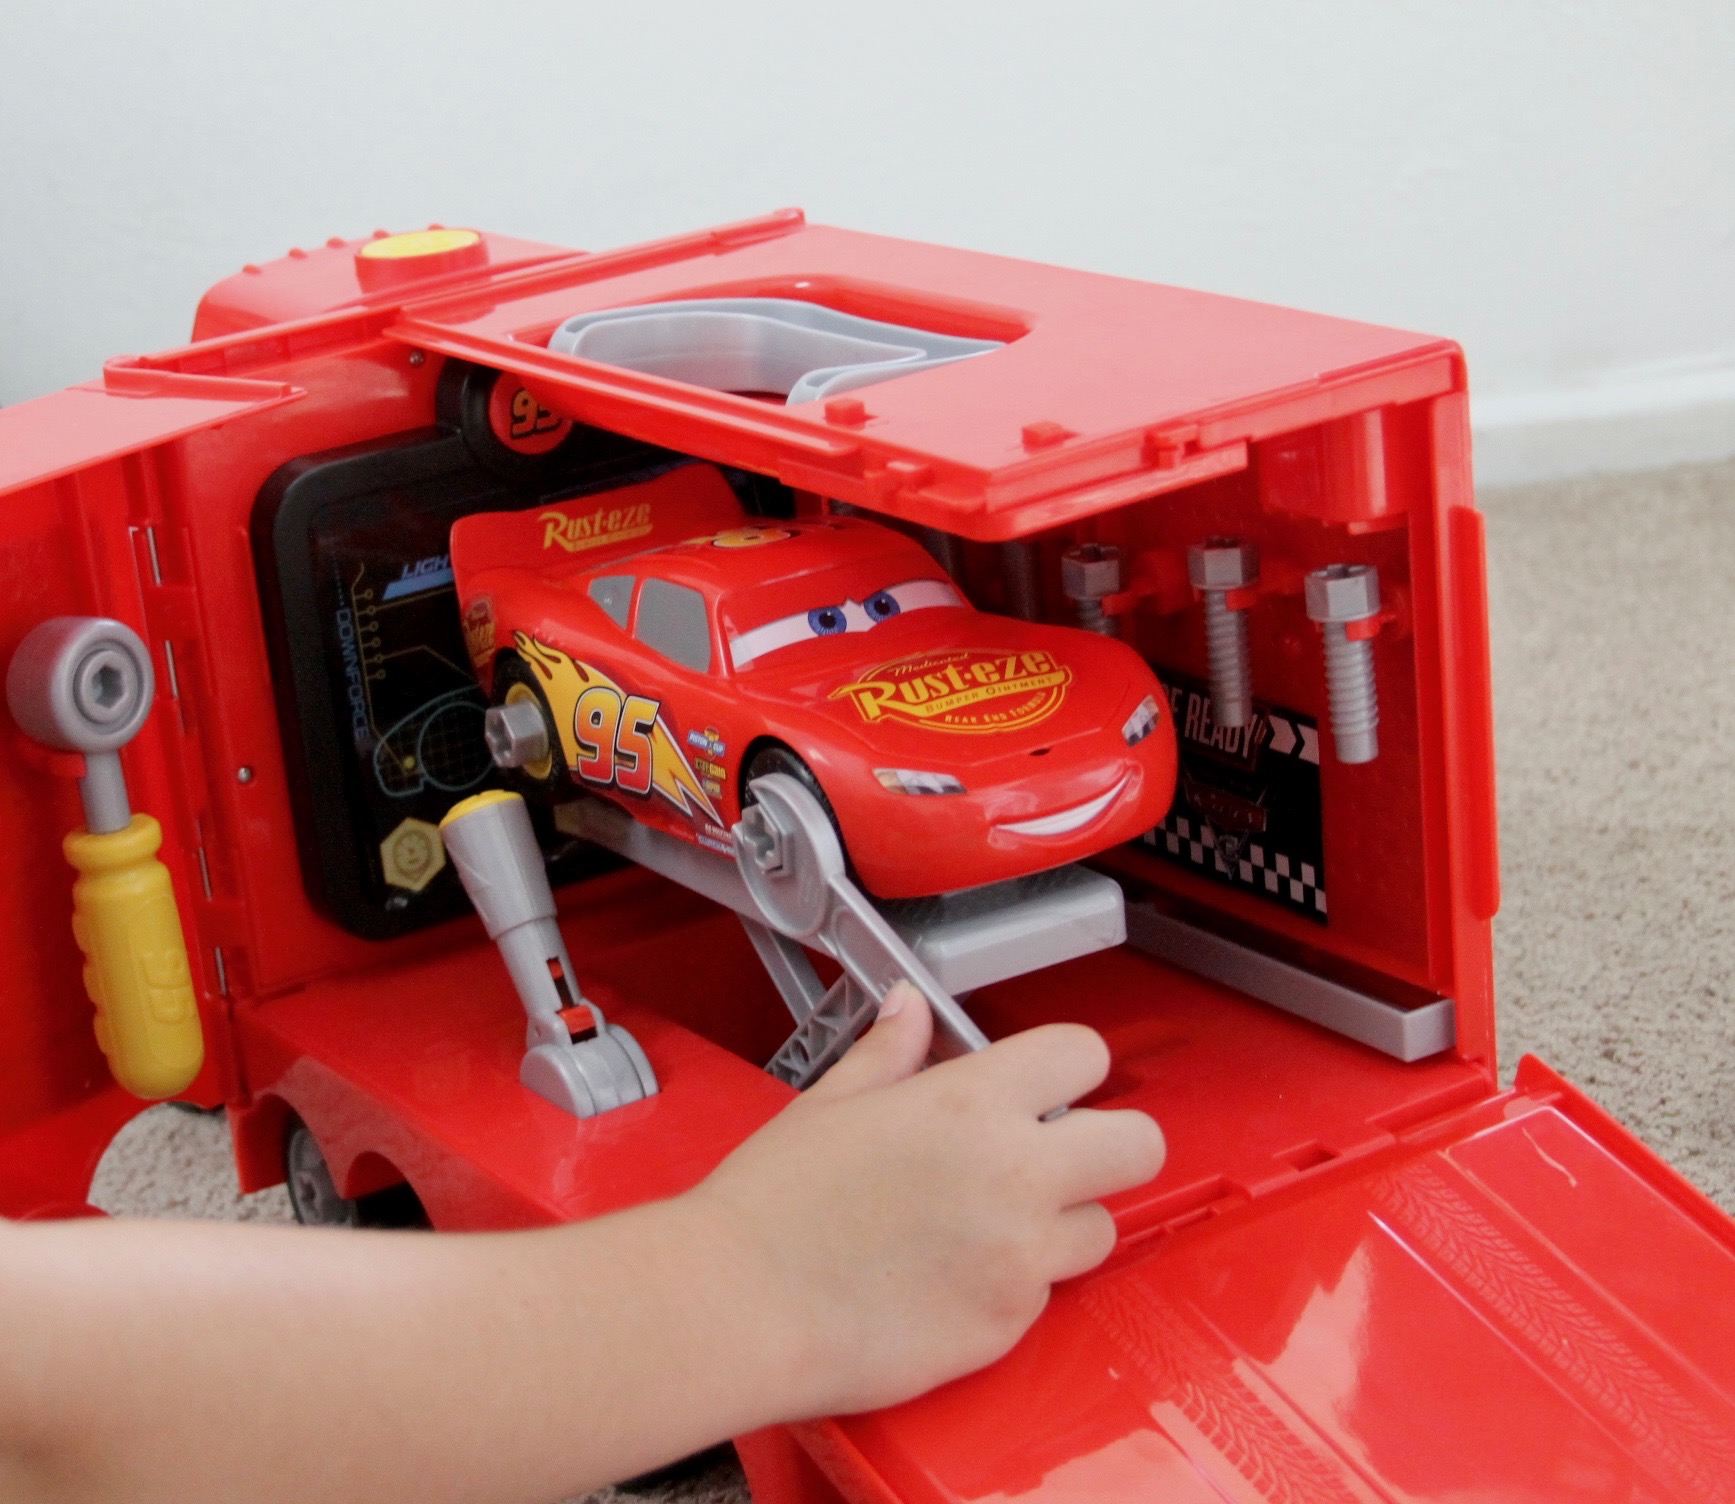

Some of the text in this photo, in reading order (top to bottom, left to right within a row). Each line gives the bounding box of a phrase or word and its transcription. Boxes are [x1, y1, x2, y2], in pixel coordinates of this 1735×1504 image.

[401, 555, 450, 580] LIGH
[336, 607, 370, 739] DOWNFORCE
[888, 652, 971, 677] Medicated
[574, 686, 661, 797] 95
